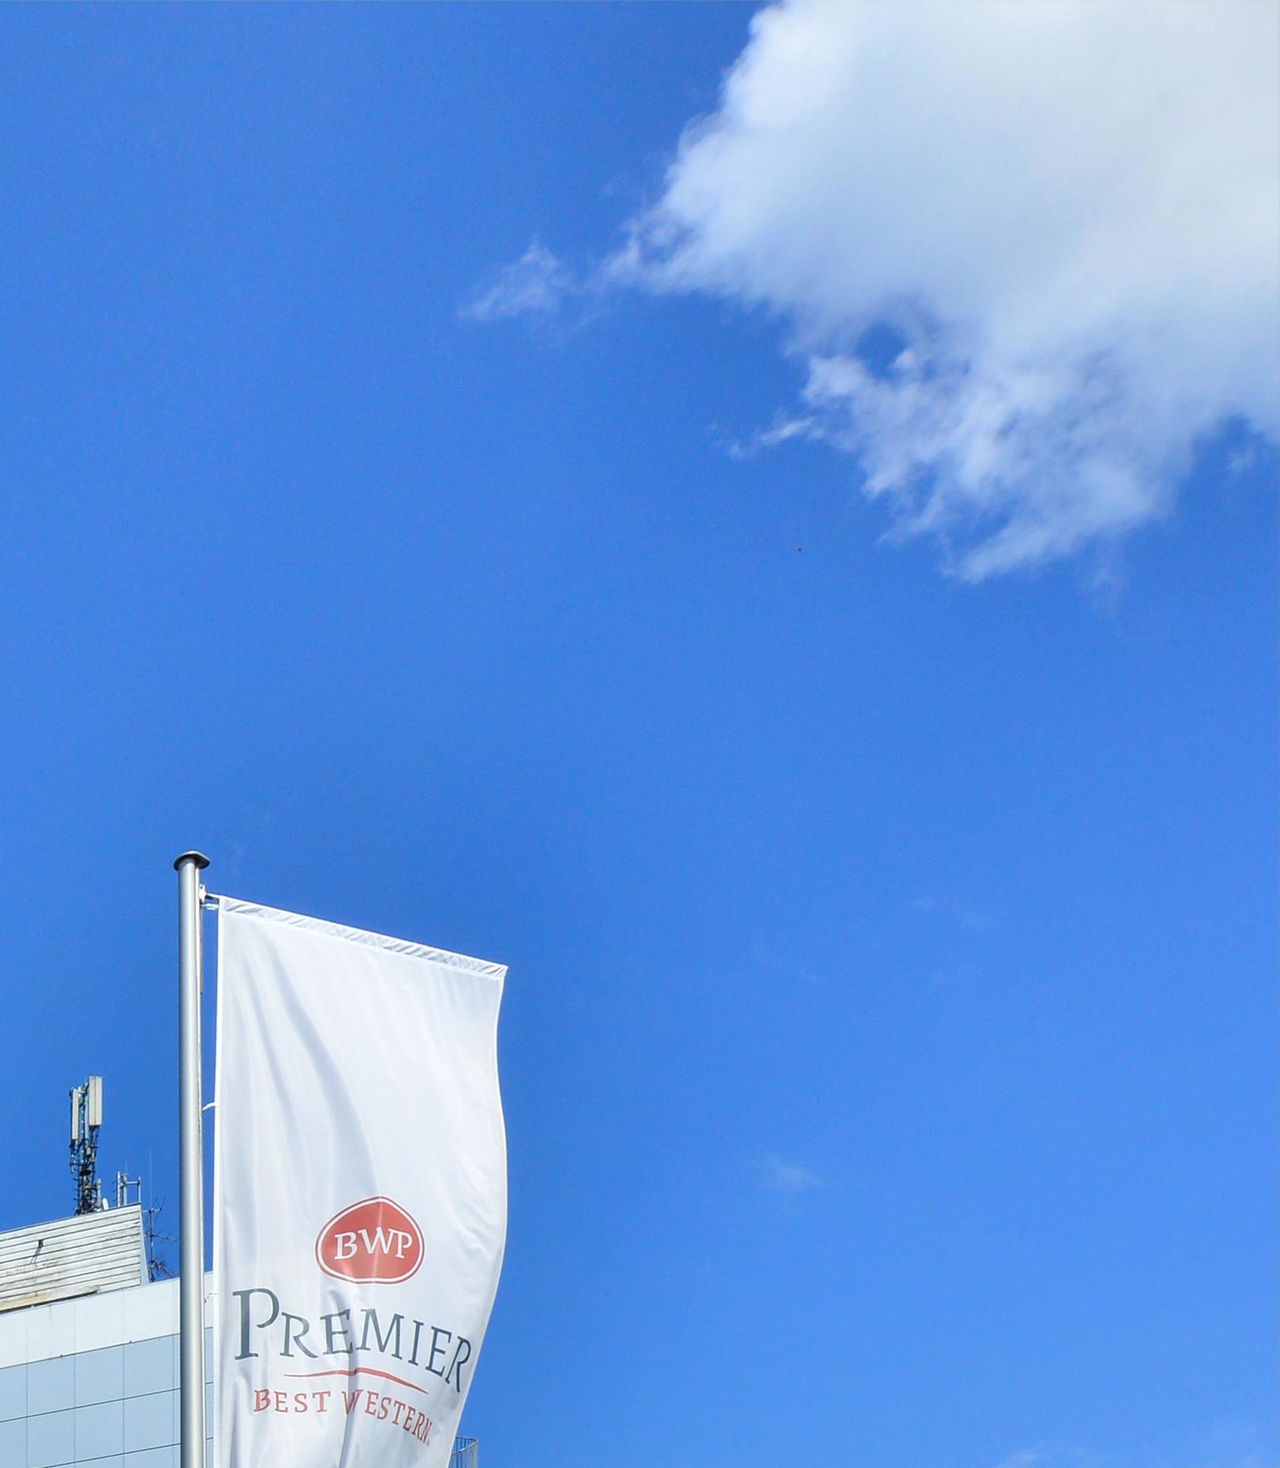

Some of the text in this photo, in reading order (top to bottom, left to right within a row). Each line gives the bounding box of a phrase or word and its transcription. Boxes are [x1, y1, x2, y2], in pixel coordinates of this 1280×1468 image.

[333, 1226, 413, 1261] BWP
[232, 1287, 472, 1393] PREMIER
[253, 1388, 432, 1443] BEST WESTERN
